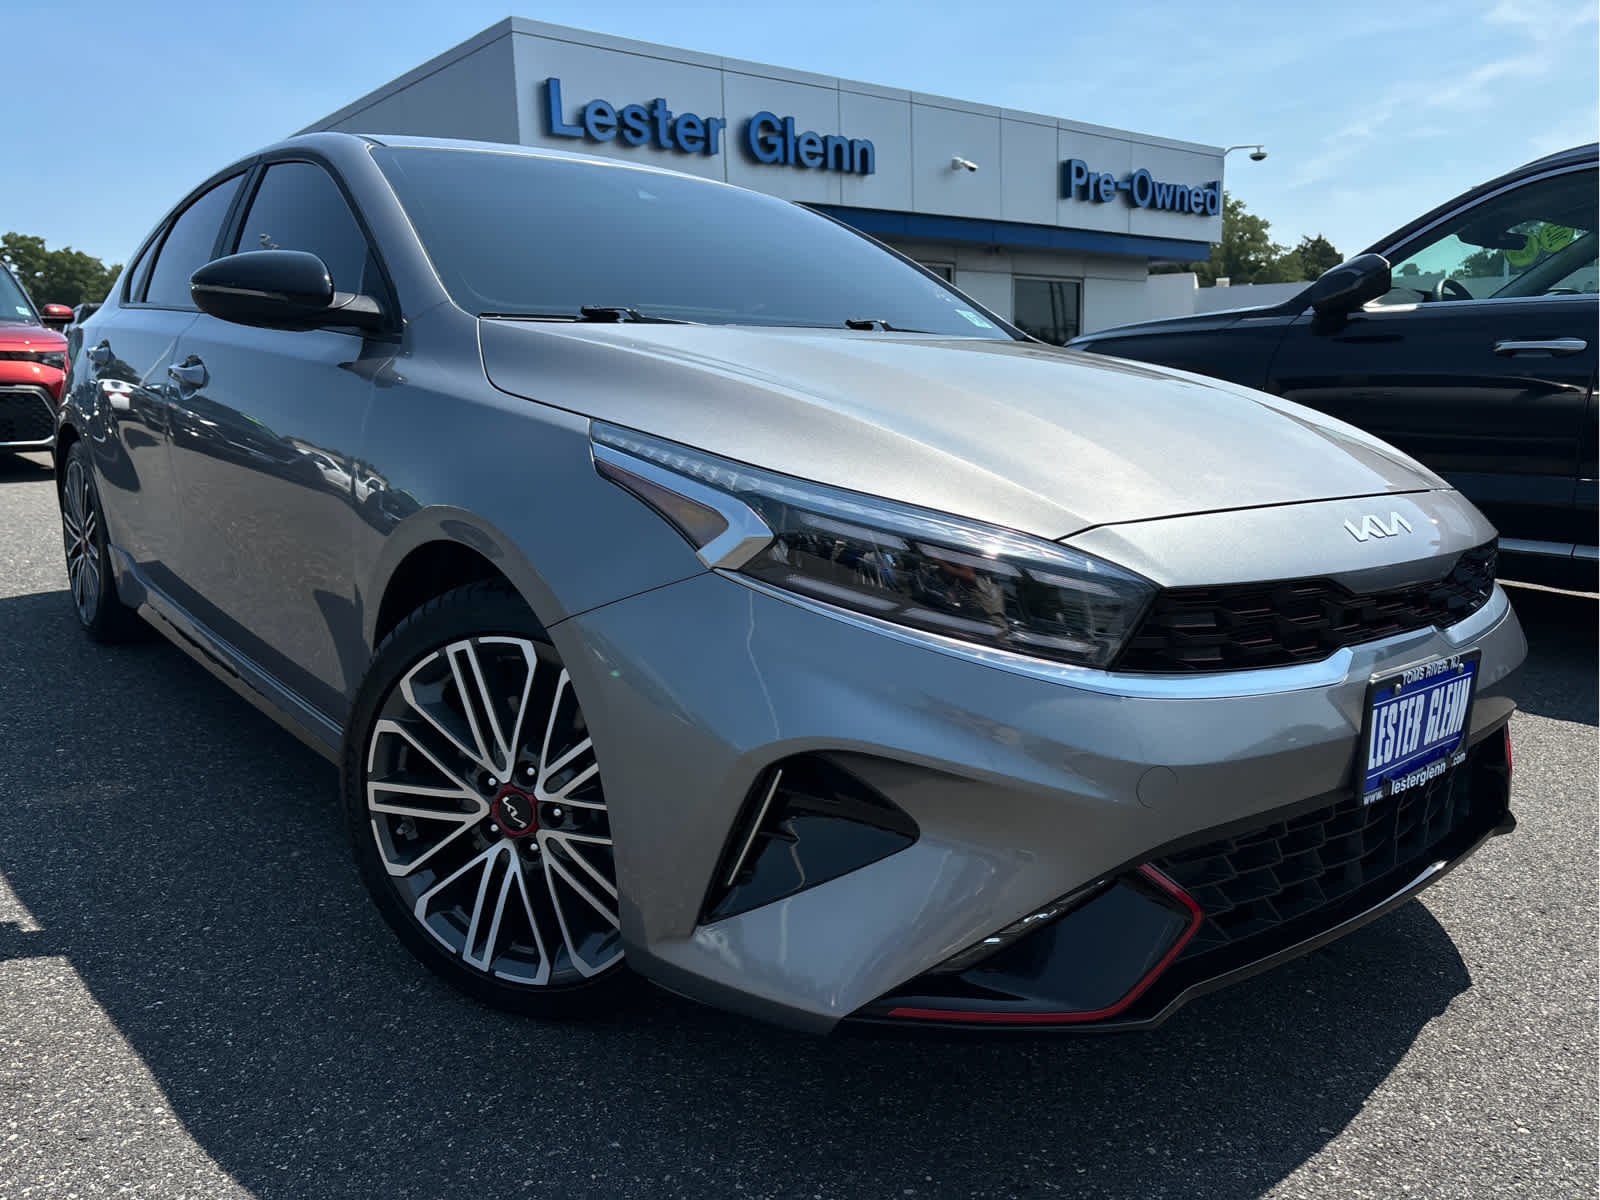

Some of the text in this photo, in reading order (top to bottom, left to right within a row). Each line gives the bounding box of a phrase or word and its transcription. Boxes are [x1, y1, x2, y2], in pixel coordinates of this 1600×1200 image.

[543, 77, 875, 175] Lester Glenn
[1062, 158, 1221, 216] Pre-Owned
[1401, 666, 1425, 686] TOMS
[1450, 655, 1461, 671] NJ
[1368, 677, 1471, 770] LESTER GLENN
[1391, 761, 1446, 795] lesterglenn
